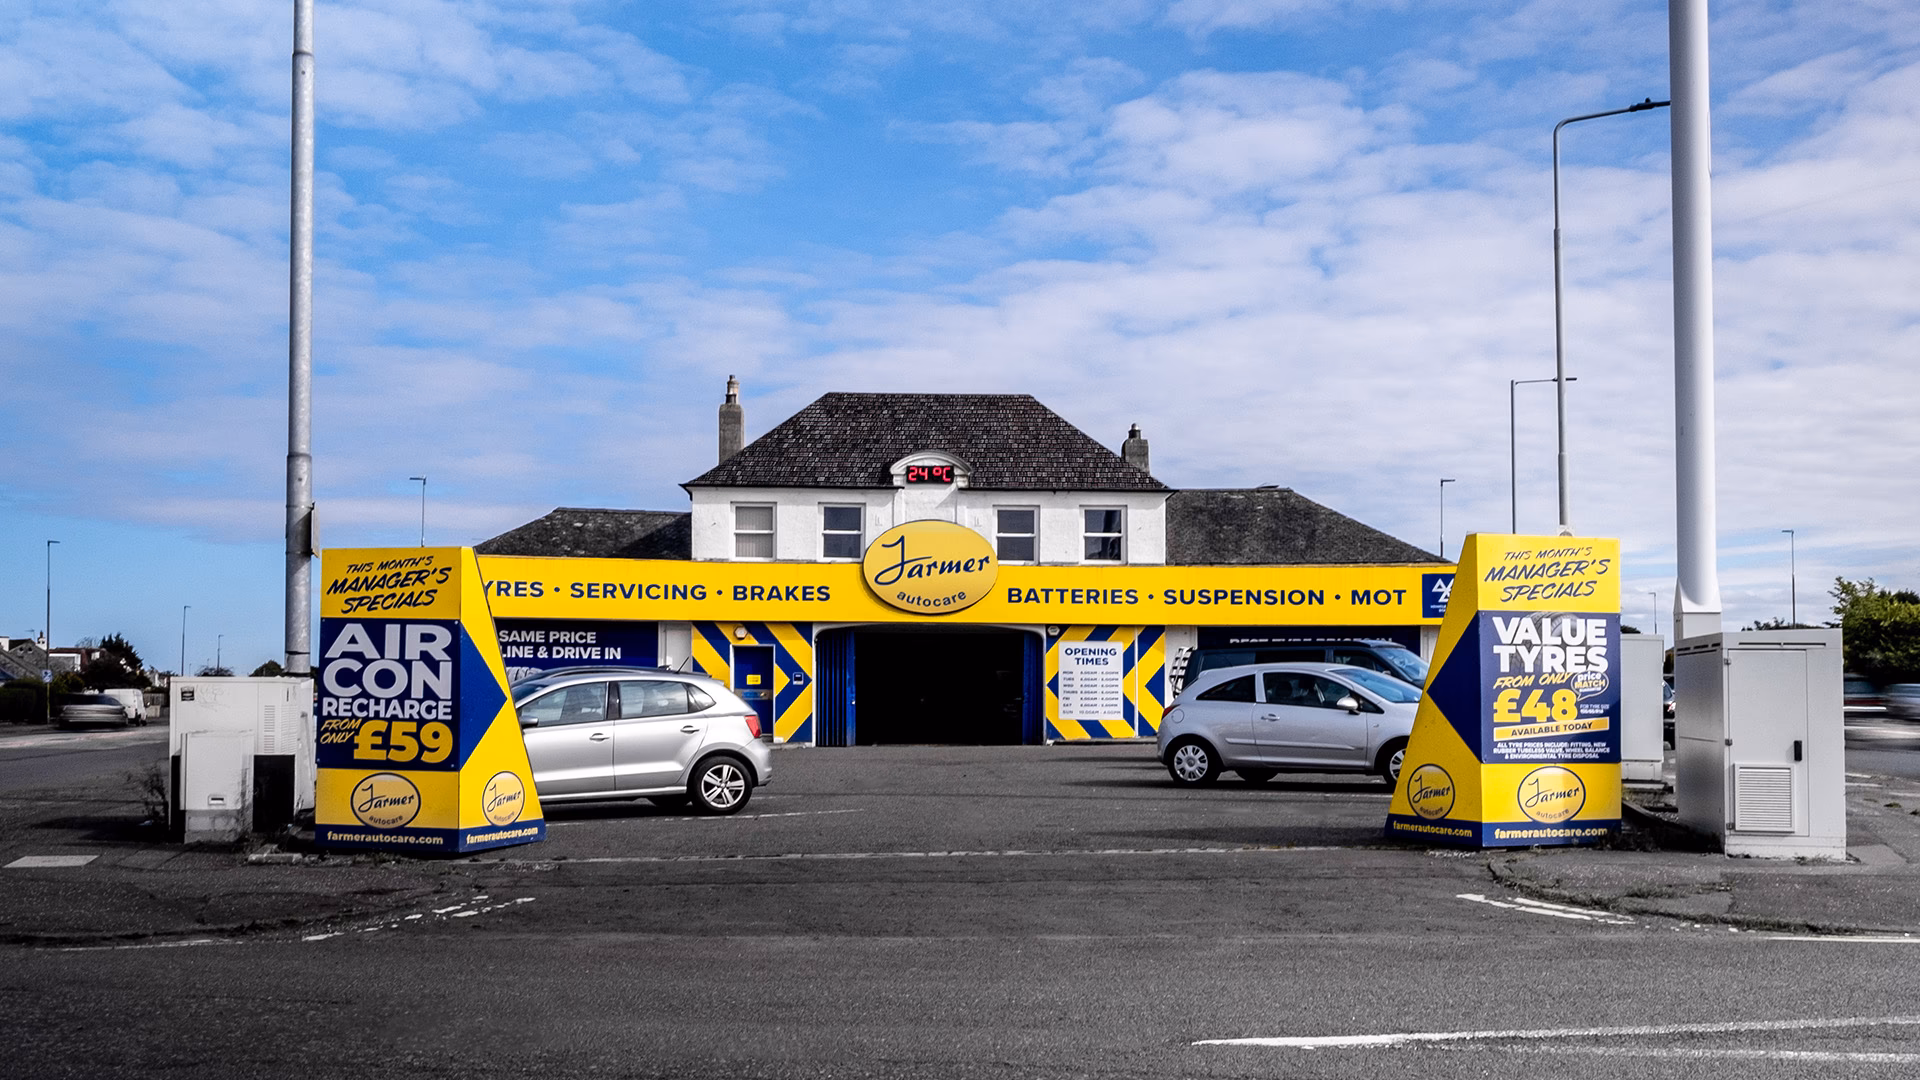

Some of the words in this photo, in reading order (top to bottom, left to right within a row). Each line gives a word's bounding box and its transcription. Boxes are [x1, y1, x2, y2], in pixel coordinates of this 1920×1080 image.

[908, 466, 928, 482] 24
[874, 535, 990, 586] Farmer
[1503, 551, 1532, 561] THIS
[1535, 546, 1592, 559] MONTH'S
[346, 562, 373, 574] THIS
[376, 555, 434, 571] MONTH'S
[1484, 558, 1611, 582] MANAGER'S
[326, 567, 452, 595] MANAGER'S
[484, 580, 544, 598] YRES
[570, 582, 707, 601] SERVICING
[732, 585, 831, 602] BRAKES
[1007, 587, 1139, 605] BATTERIES
[1163, 588, 1325, 606] SUSPENSION
[1351, 589, 1407, 606] MOT
[896, 591, 967, 607] autocare
[1499, 580, 1598, 603] SPECIALS
[341, 589, 438, 614] SPECIALS
[499, 630, 545, 642] SAME
[549, 631, 597, 644] PRICE
[1492, 616, 1607, 646] VALUE
[324, 623, 452, 661] AIR
[537, 646, 549, 659] &
[552, 646, 601, 660] DRIVE
[604, 647, 622, 660] IN
[1064, 647, 1117, 656] OPENING
[1492, 645, 1609, 674] TYRES
[1074, 657, 1109, 666] TIMES
[322, 658, 452, 700] CON
[1493, 674, 1535, 689] FROM
[1539, 672, 1573, 686] ONLY
[1574, 679, 1606, 689] MATCH
[1577, 671, 1602, 682] price
[322, 697, 452, 720] RECHARGE
[1493, 688, 1578, 723] £48
[320, 718, 362, 732] FROM
[1511, 725, 1560, 737] AVAILABLE
[1563, 722, 1593, 732] TODAY
[320, 731, 355, 744] ONLY
[353, 719, 453, 763] £59
[358, 783, 415, 813] Farmer
[486, 783, 521, 812] Farmer
[1412, 774, 1451, 804] Farmer
[1525, 778, 1580, 808] Farmer
[368, 815, 404, 826] autocare
[493, 811, 515, 822] autocare
[1419, 806, 1444, 817] autocare
[1535, 808, 1570, 819] autocare
[327, 831, 444, 845] farmerautocare.com
[466, 826, 538, 845] farmerautocare.com
[1393, 820, 1473, 838] farmerautocare.com
[1494, 827, 1608, 840] farmerautocare.com
